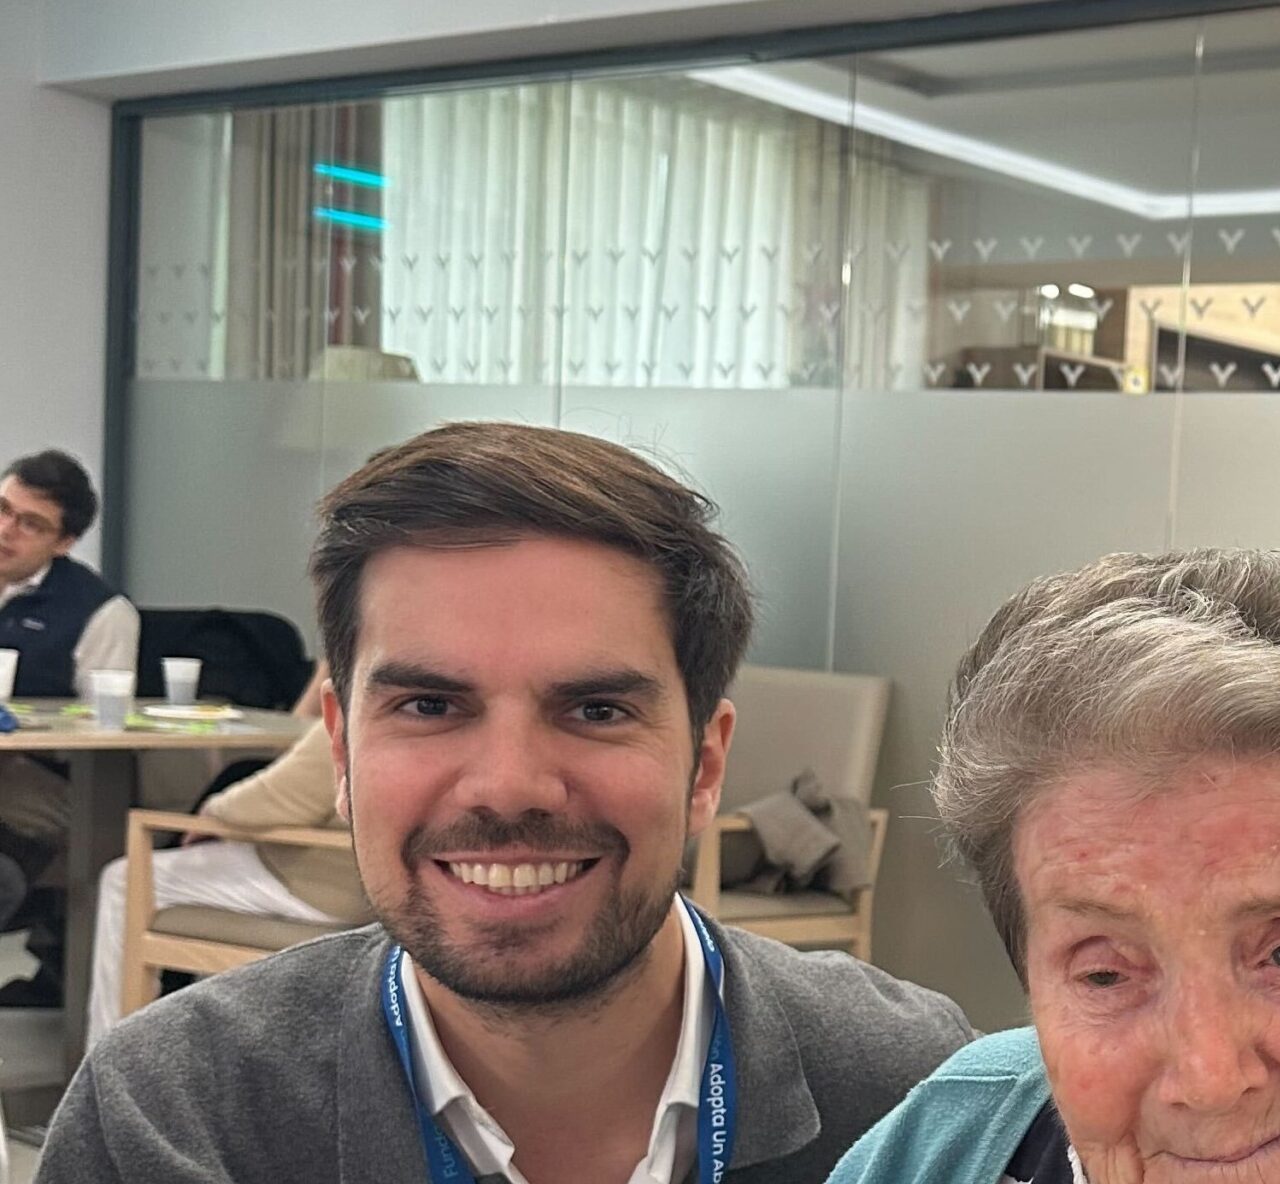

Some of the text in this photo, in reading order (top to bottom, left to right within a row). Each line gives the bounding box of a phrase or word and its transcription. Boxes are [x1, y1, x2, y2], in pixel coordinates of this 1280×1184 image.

[388, 963, 403, 1027] Adopta
[706, 1063, 727, 1127] Adopta
[712, 1131, 727, 1156] Un
